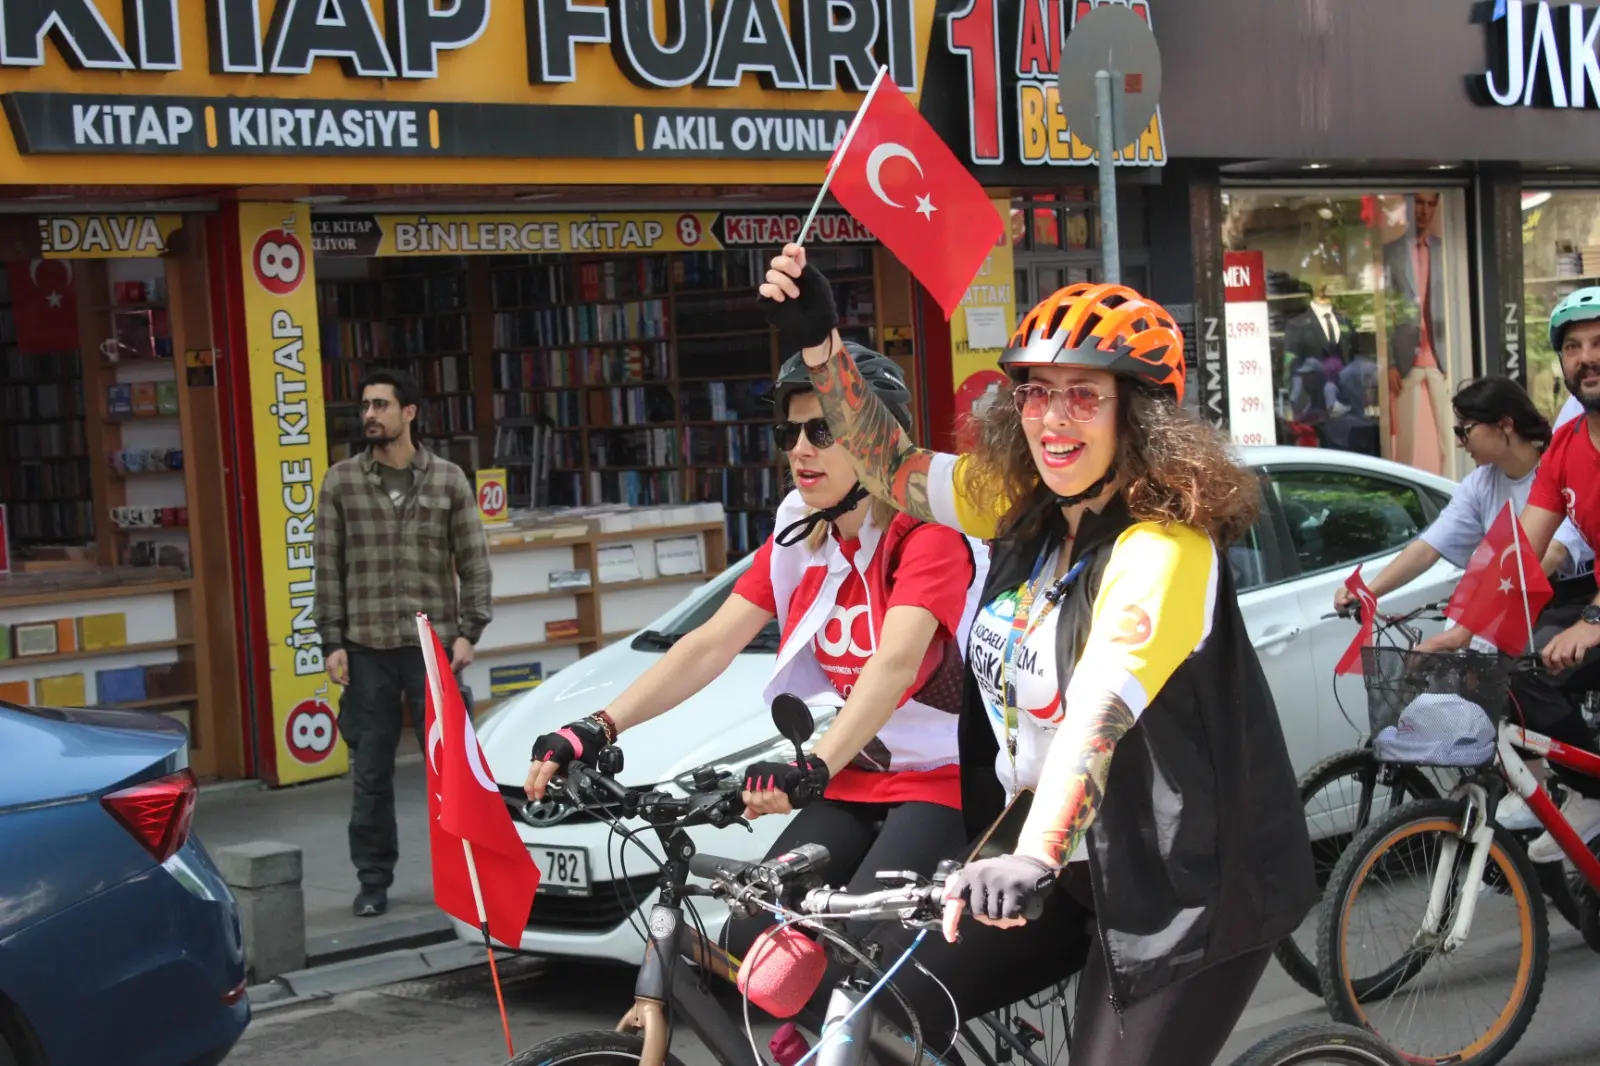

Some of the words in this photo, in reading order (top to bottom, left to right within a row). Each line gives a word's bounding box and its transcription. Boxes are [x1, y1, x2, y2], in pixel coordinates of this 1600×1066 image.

[653, 116, 724, 150] AKIL
[679, 217, 698, 245] 8
[259, 240, 302, 284] 8
[482, 486, 503, 510] 20
[291, 711, 334, 752] 8
[546, 851, 580, 883] 782
